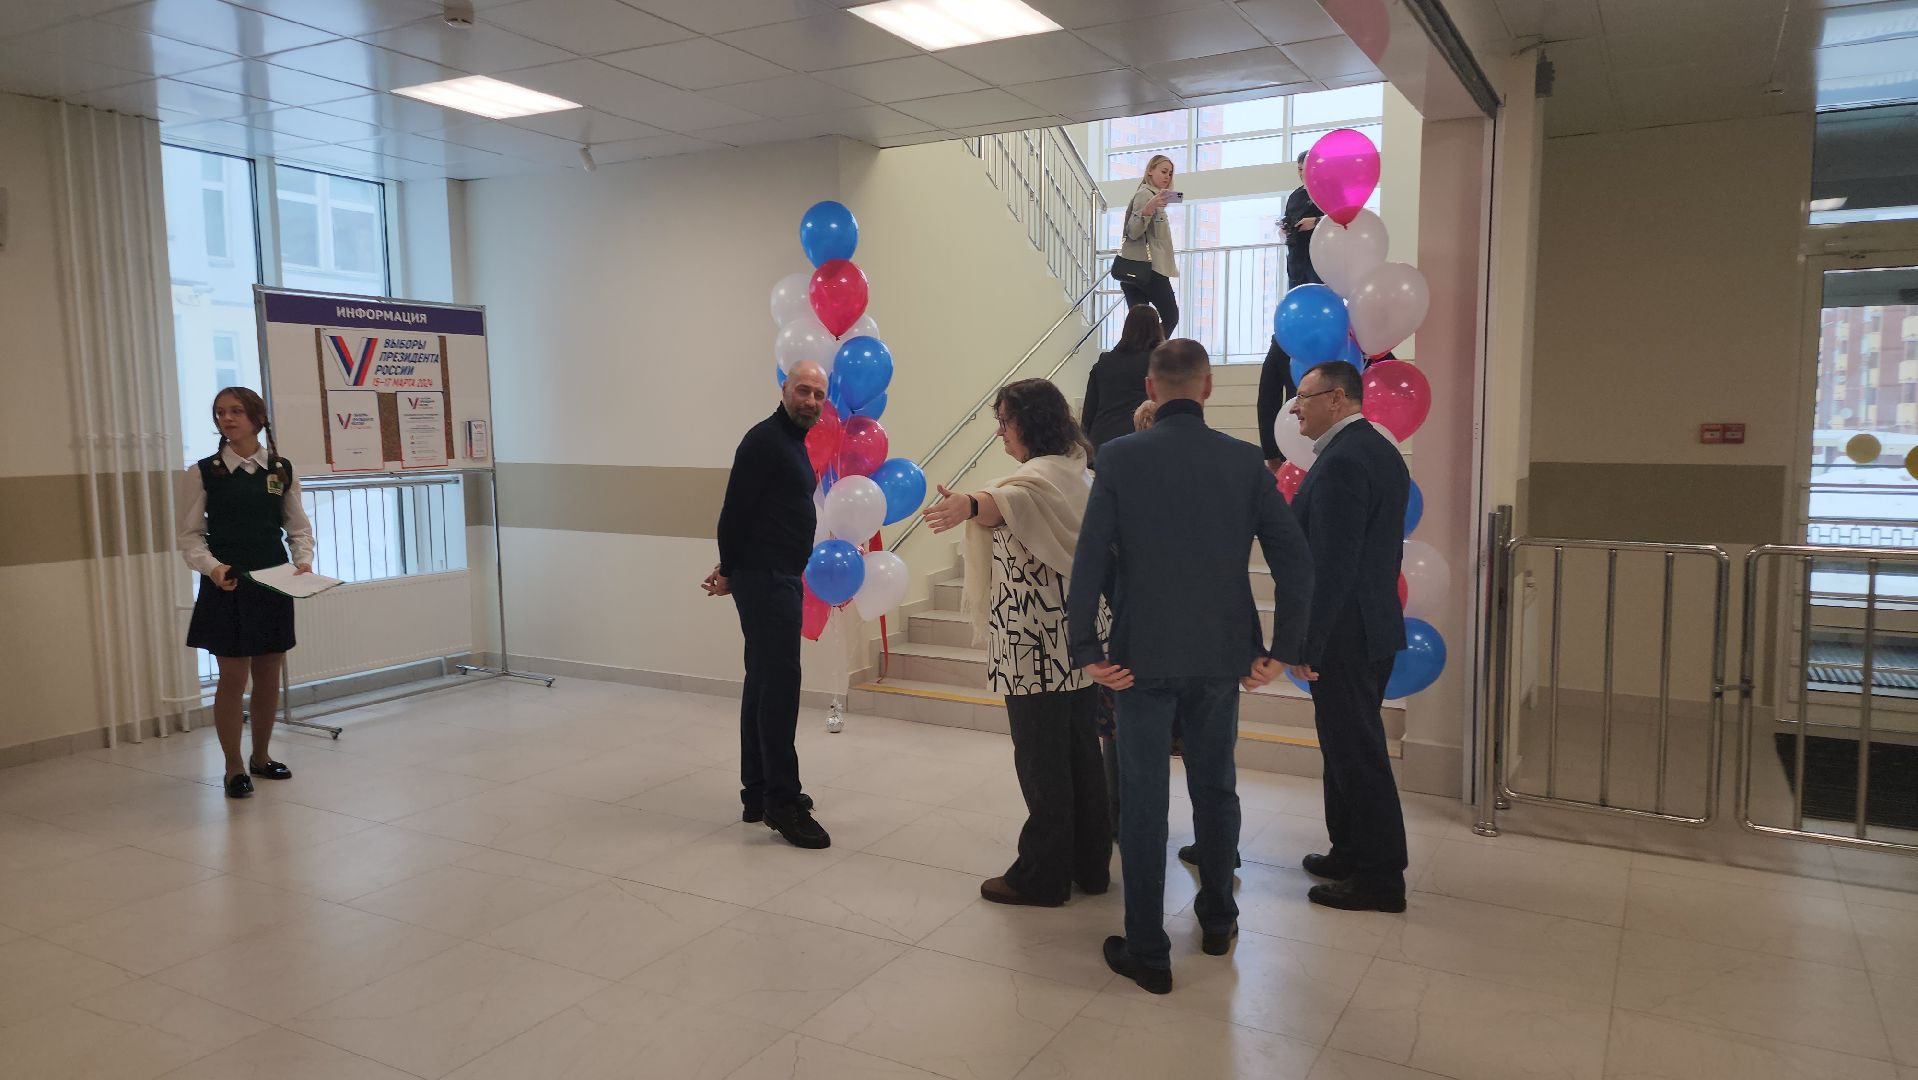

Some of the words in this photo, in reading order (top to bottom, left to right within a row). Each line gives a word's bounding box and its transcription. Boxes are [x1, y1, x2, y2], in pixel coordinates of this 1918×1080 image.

[336, 306, 427, 324] ИНФОРМАЦИЯ
[384, 338, 427, 350] ВЫБОРЫ
[379, 351, 440, 363] ПРЕЗИДЕНТА
[375, 365, 414, 376] РОССИИ
[392, 377, 416, 388] МАРТА
[416, 378, 433, 388] 2024
